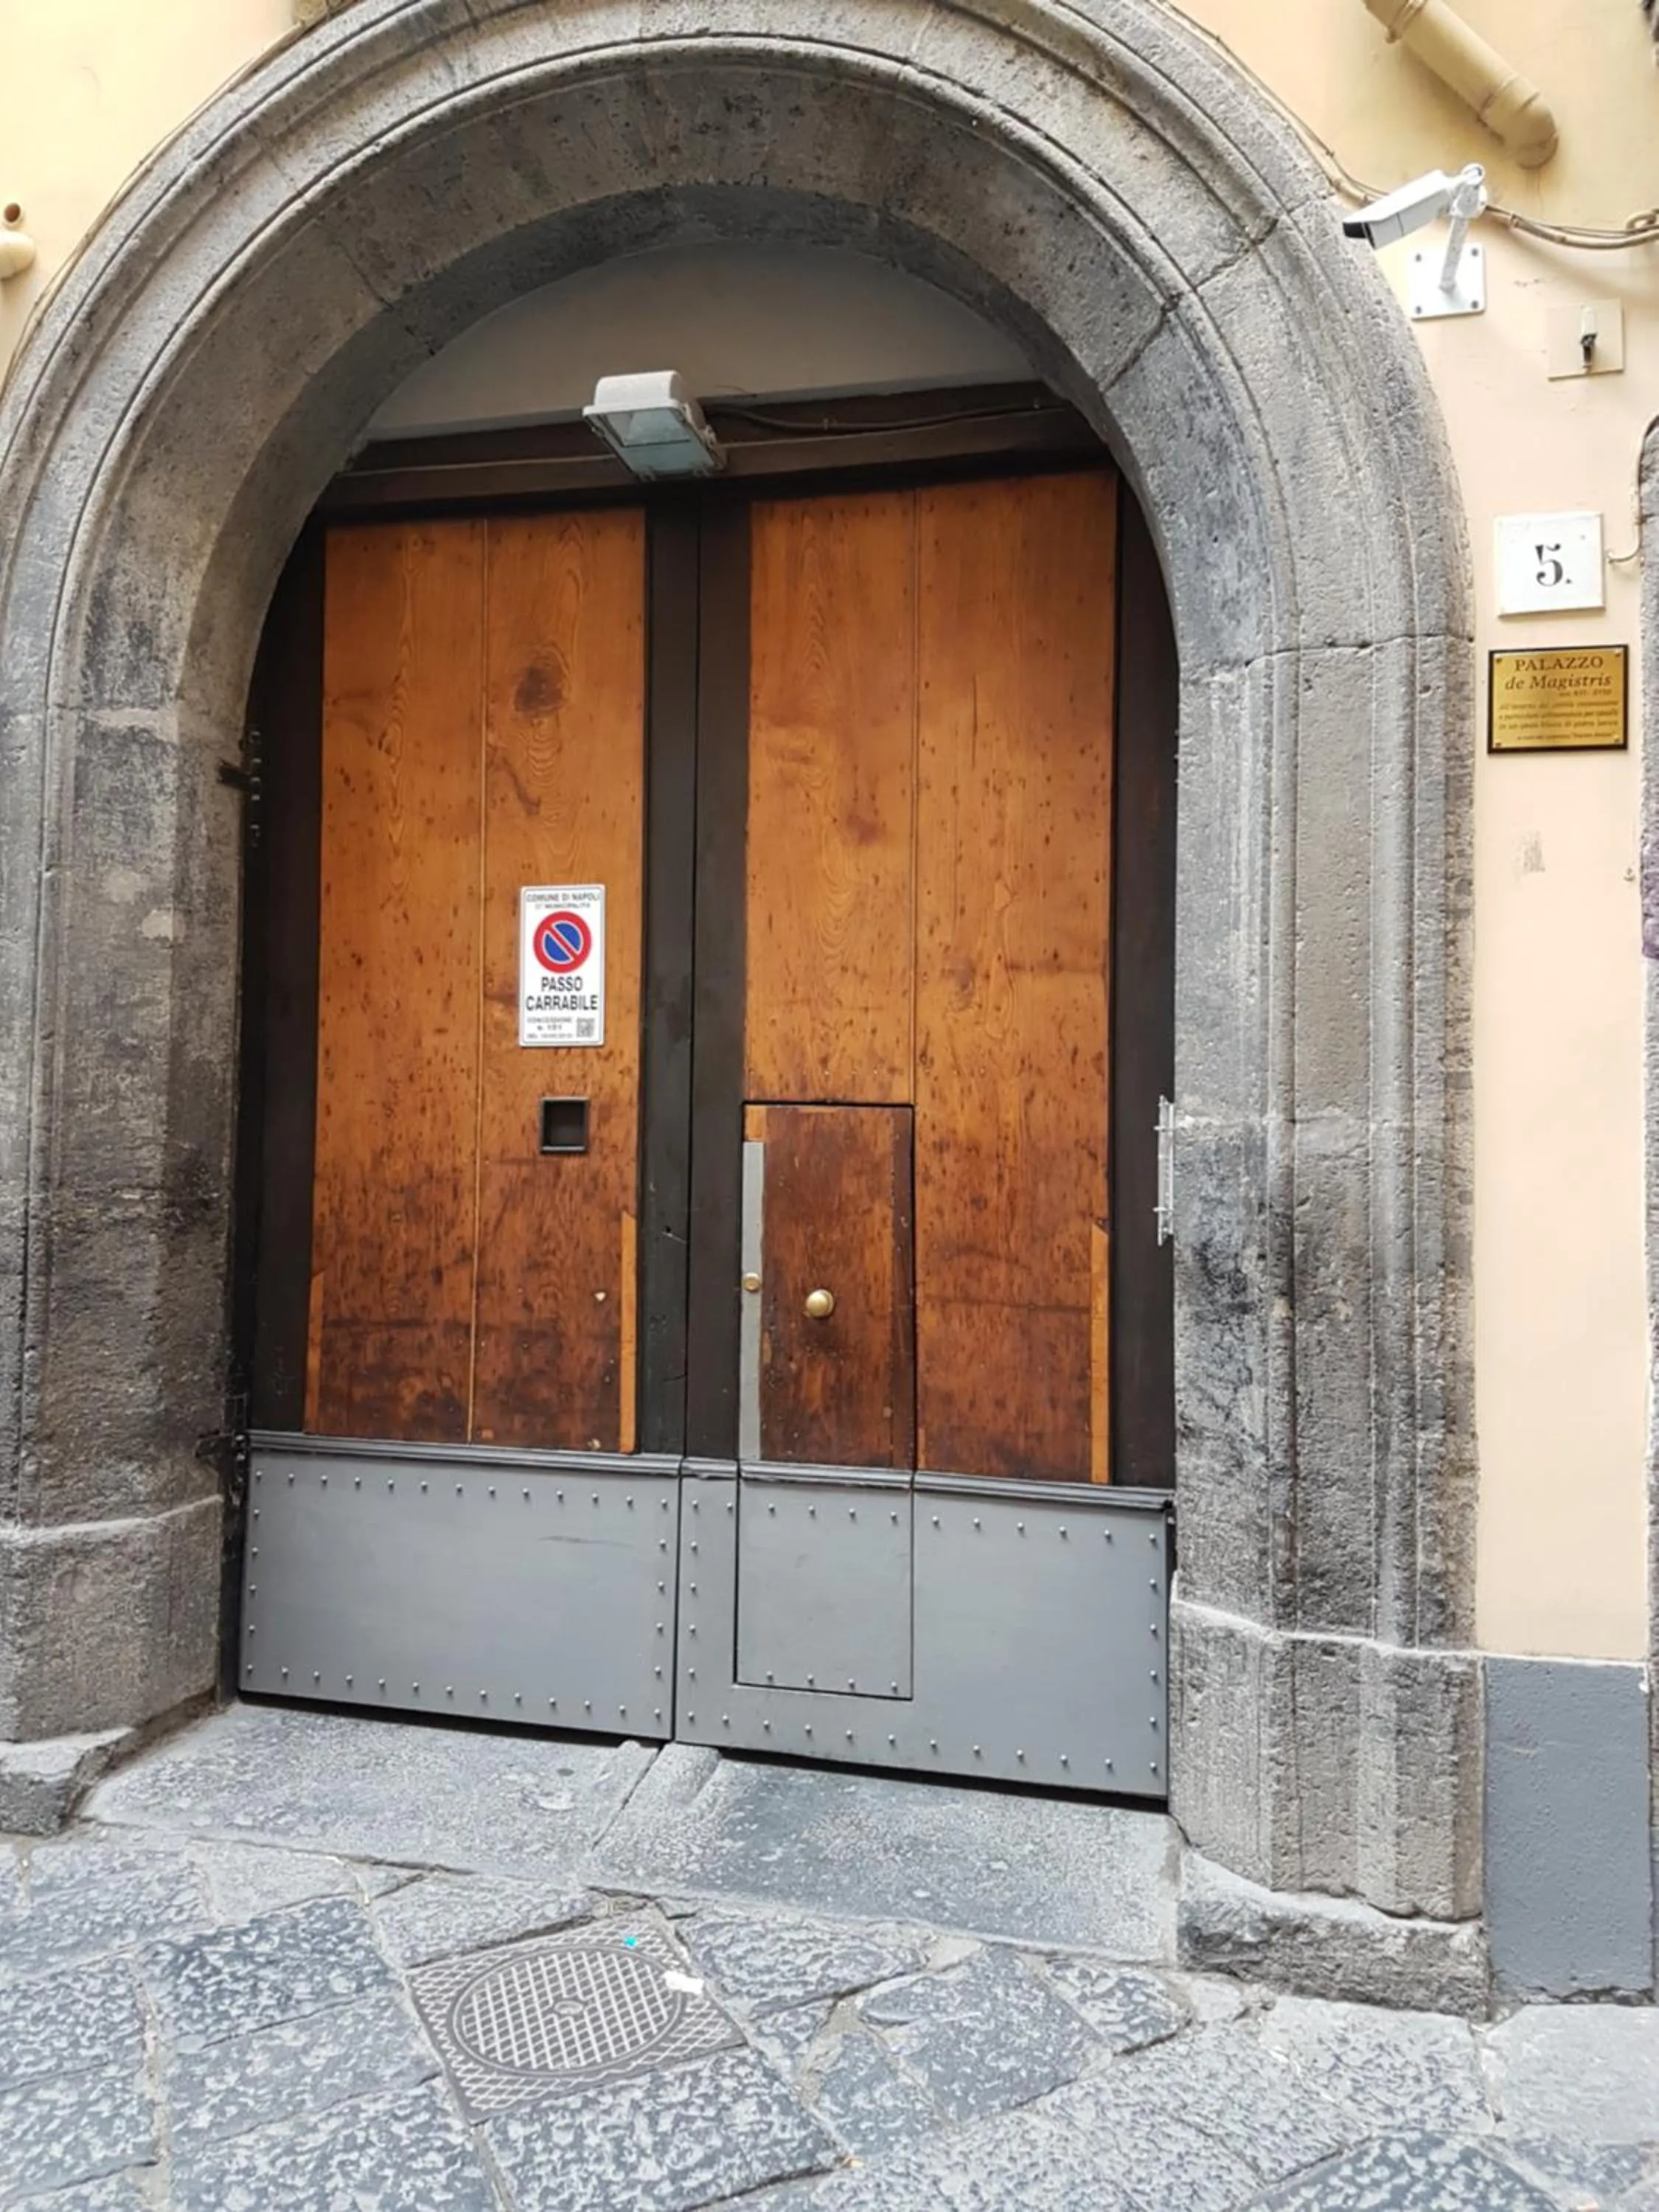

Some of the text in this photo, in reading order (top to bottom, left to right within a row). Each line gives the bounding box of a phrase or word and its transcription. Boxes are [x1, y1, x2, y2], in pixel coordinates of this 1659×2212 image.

[1514, 655, 1604, 672] PALAZZO
[1505, 672, 1613, 691] de Magistris
[526, 891, 601, 902] COMUNE DI NAPOLI
[541, 976, 583, 992] PASSO
[526, 994, 599, 1011] CARRABILE
